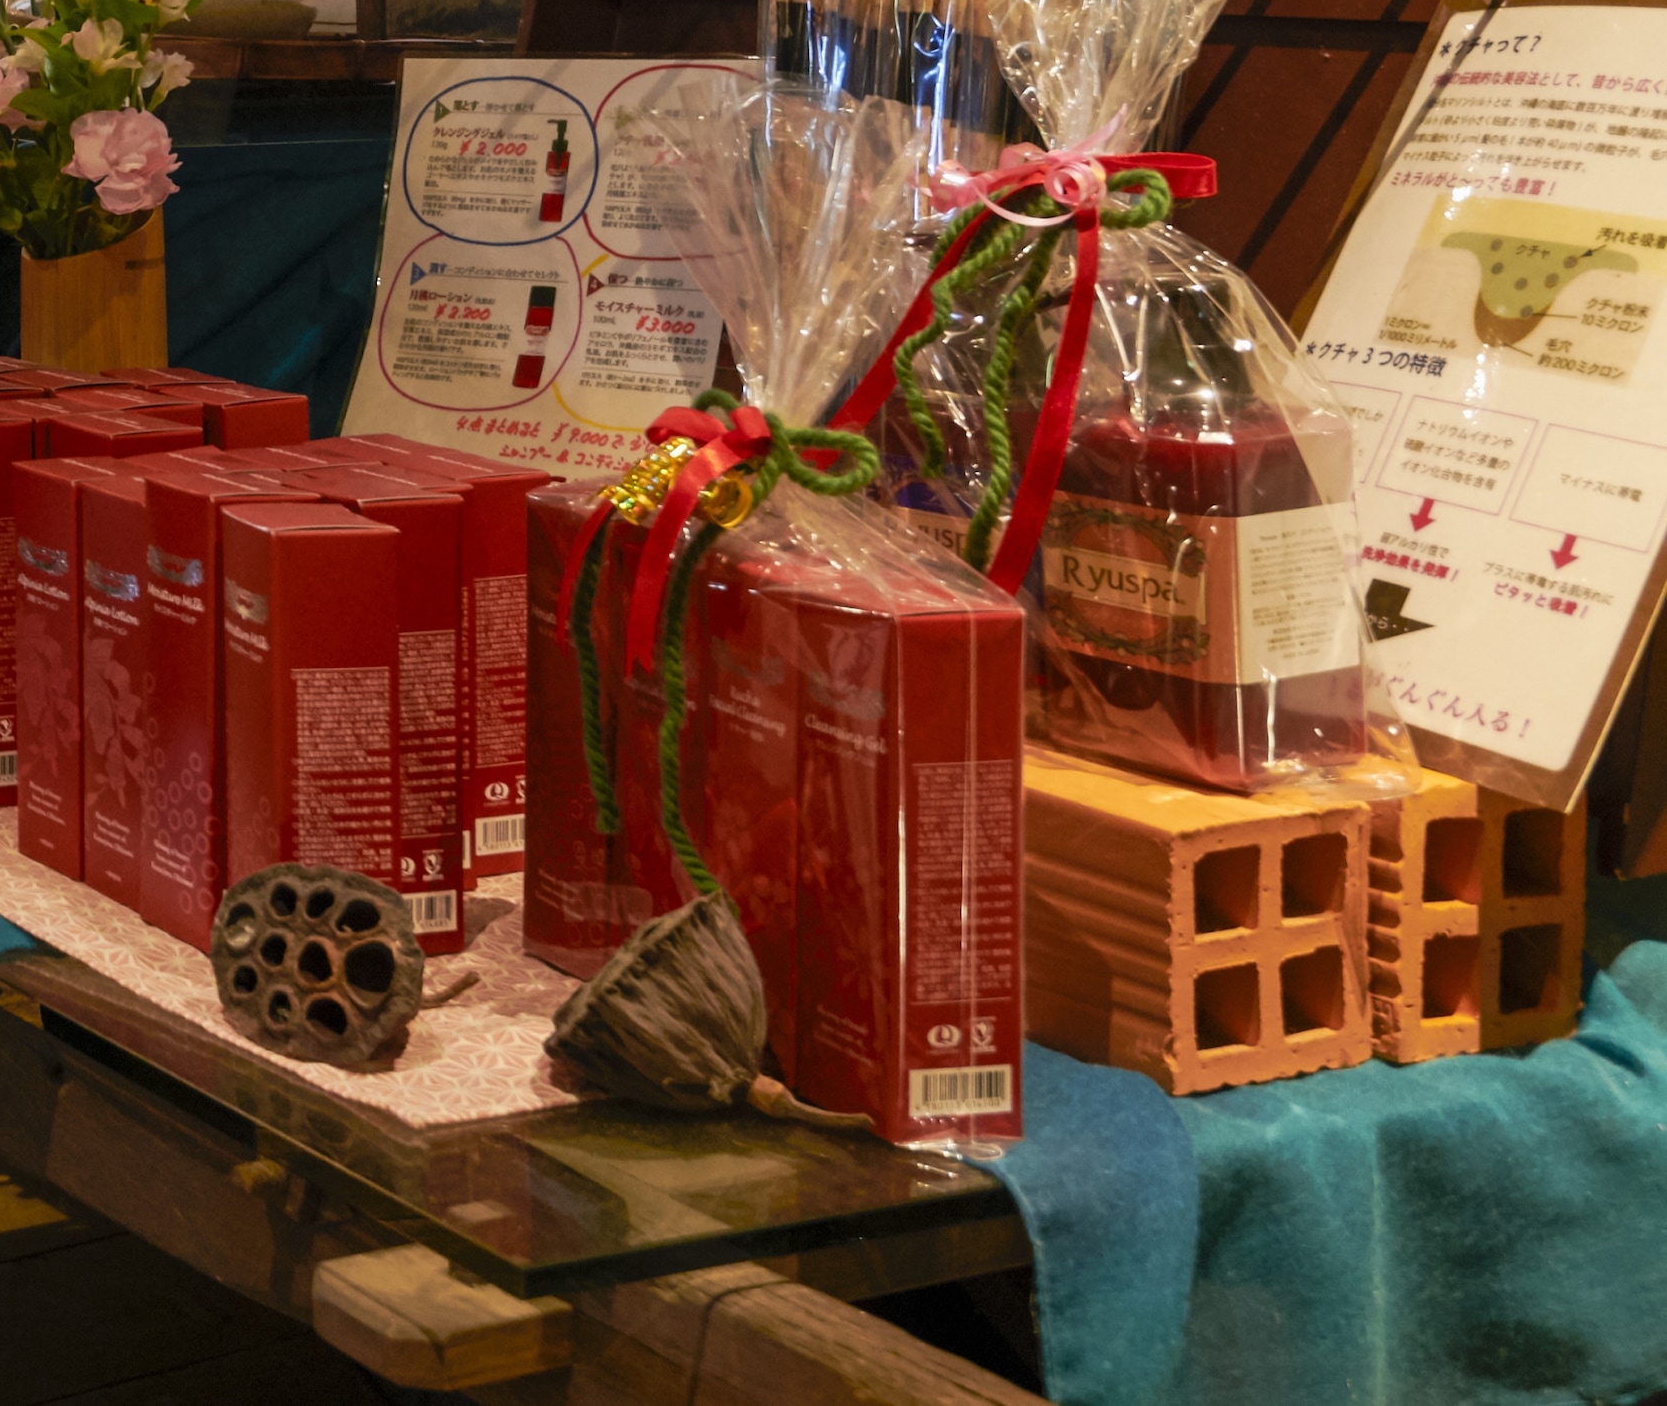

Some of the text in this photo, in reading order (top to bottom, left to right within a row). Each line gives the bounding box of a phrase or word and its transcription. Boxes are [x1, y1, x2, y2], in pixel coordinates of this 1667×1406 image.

[1515, 244, 1551, 259] クチャ
[595, 301, 685, 316] モイスチャーミルク
[1544, 338, 1573, 353] 毛穴
[1417, 419, 1514, 448] ナトリウムイオンや
